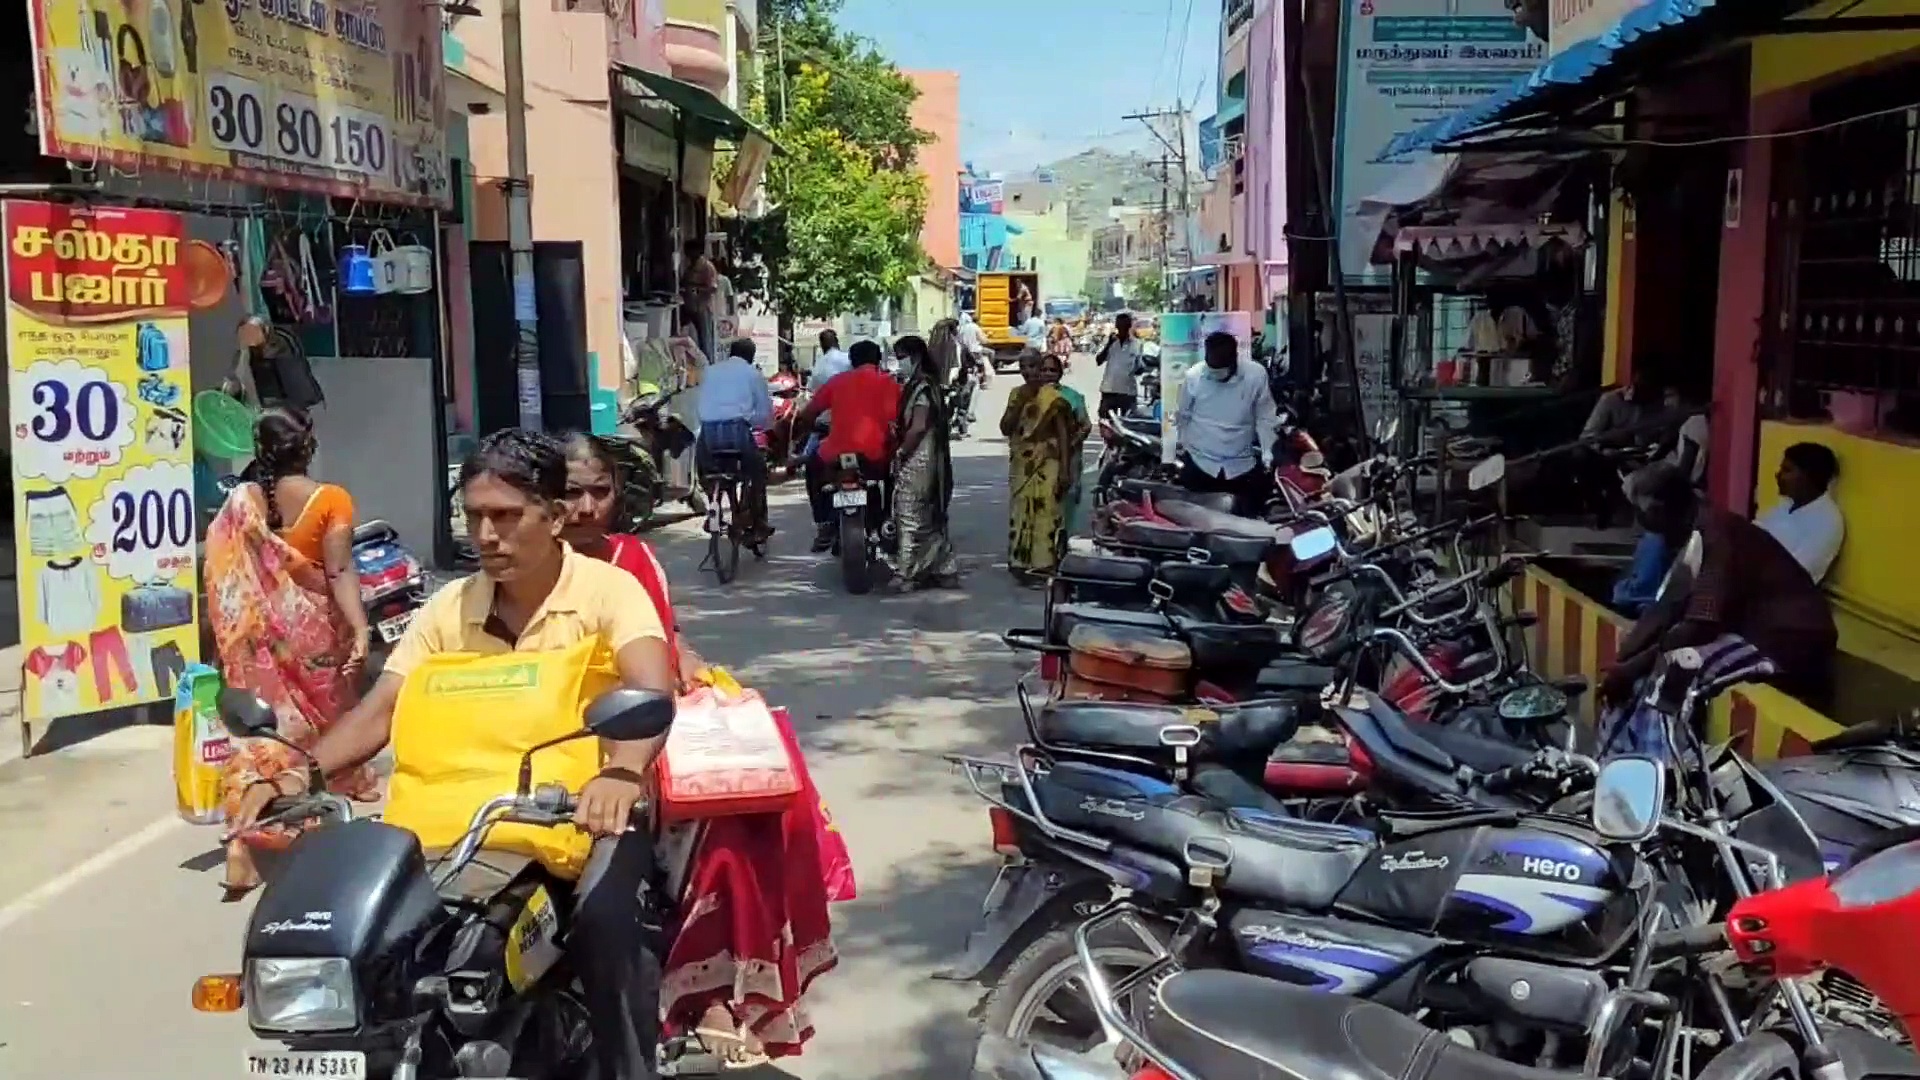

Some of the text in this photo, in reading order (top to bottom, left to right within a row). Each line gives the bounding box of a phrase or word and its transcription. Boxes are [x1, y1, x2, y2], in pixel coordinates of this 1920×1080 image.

[210, 86, 263, 149] 30
[276, 103, 322, 159] 80
[330, 116, 386, 171] 150
[12, 218, 180, 274] சஸ்தா
[30, 268, 169, 306] பஜார்
[32, 380, 119, 442] 30
[112, 488, 192, 553] 200
[1523, 856, 1581, 881] Hero
[249, 1056, 267, 1074] TN
